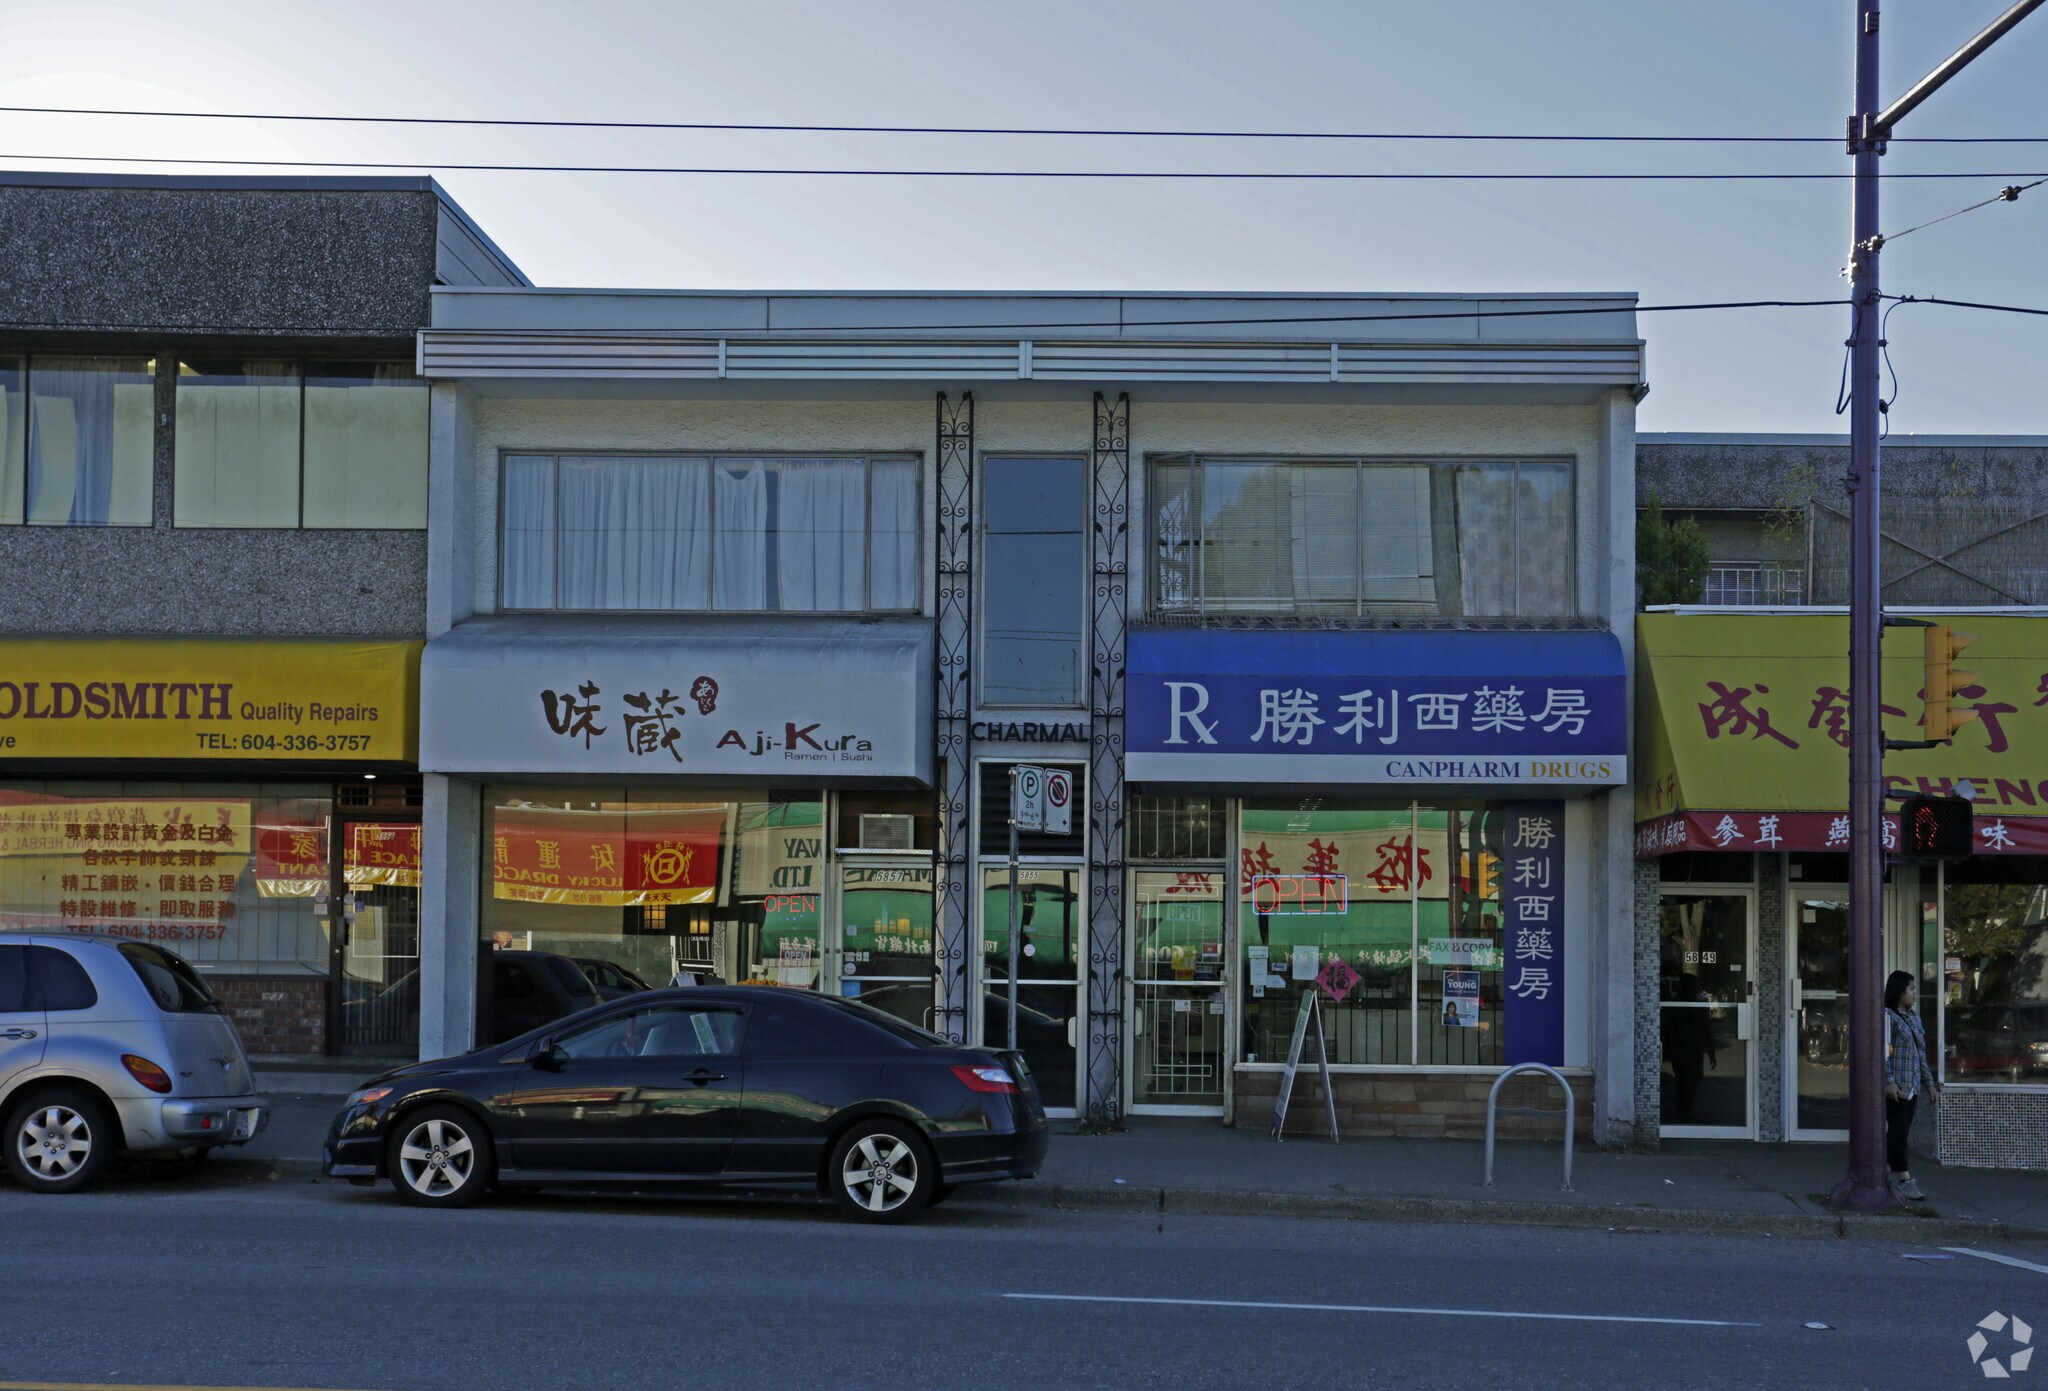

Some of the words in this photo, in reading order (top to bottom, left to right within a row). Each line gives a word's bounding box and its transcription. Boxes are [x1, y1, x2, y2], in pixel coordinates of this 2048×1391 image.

[240, 703, 304, 725] Quality
[309, 703, 378, 725] Repairs
[1250, 685, 1591, 745] 勝利西藥房
[716, 722, 872, 756] Aji-Kura
[970, 722, 1089, 743] CHARMAL
[196, 733, 237, 750] TEL:
[241, 734, 371, 751] 604-336-3757
[784, 751, 827, 761] Ramen
[841, 751, 872, 761] Sushi
[1386, 760, 1521, 778] CANPHARM
[1531, 761, 1611, 779] DRUGS
[1026, 776, 1035, 792] P
[876, 871, 903, 882] 5857
[1019, 870, 1039, 880] 5855
[1254, 877, 1346, 912] OPEN
[764, 895, 815, 913] OPEN
[1169, 904, 1199, 920] OPEN
[1508, 816, 1556, 1001] 勝利西藥房
[784, 950, 807, 961] OPEN
[1429, 942, 1450, 952] FAX
[1452, 942, 1461, 953] &
[1462, 942, 1492, 953] COPY
[1447, 981, 1477, 989] YOUNG
